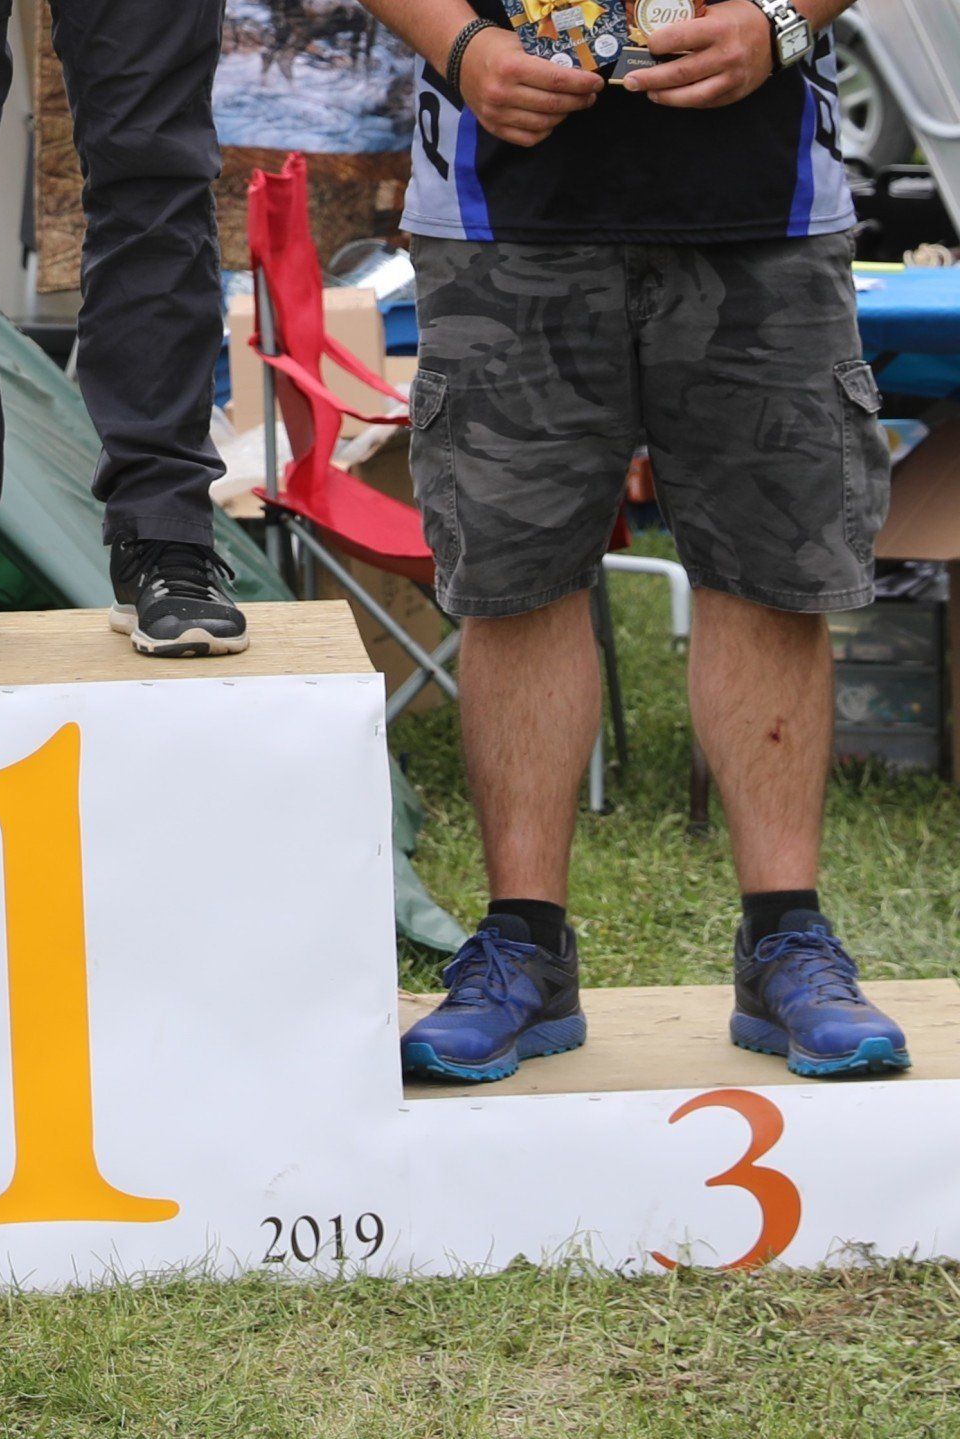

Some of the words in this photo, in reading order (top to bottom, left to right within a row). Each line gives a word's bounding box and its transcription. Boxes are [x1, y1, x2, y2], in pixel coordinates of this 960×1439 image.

[649, 7, 689, 24] 2019
[650, 1088, 802, 1270] 3
[259, 1210, 385, 1265] 2019
